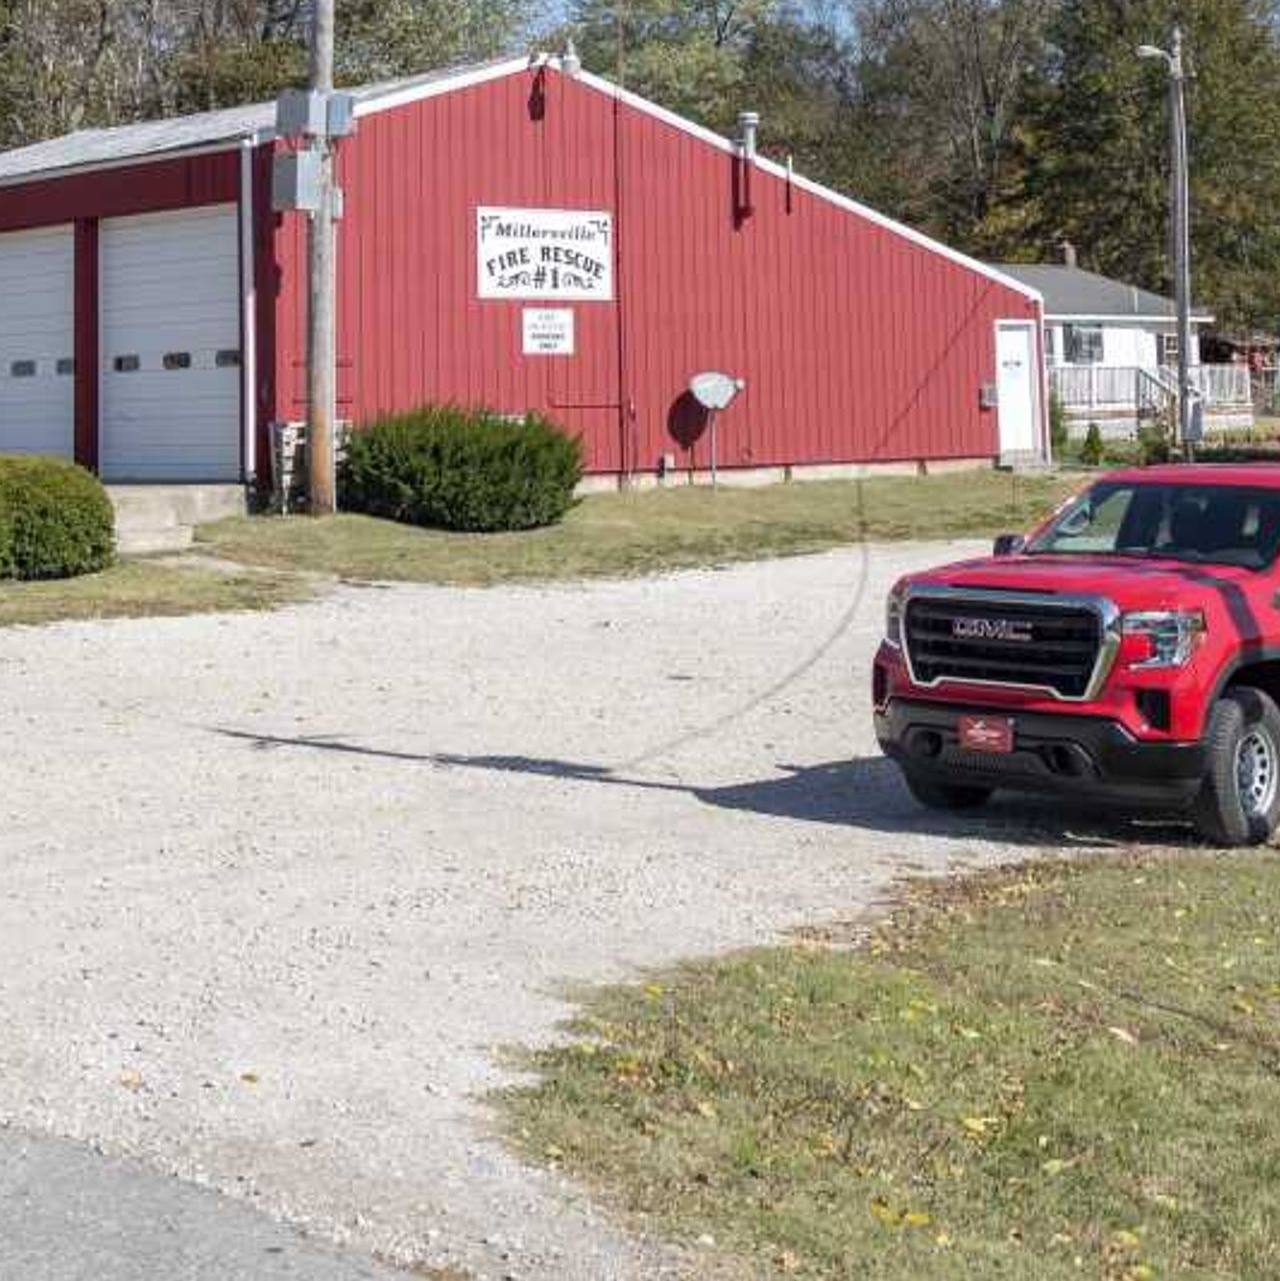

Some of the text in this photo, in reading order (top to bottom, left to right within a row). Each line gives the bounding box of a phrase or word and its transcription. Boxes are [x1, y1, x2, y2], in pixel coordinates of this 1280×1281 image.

[486, 245, 606, 280] FIRE RESCUE
[532, 265, 560, 290] #1
[952, 617, 1033, 641] GMC
